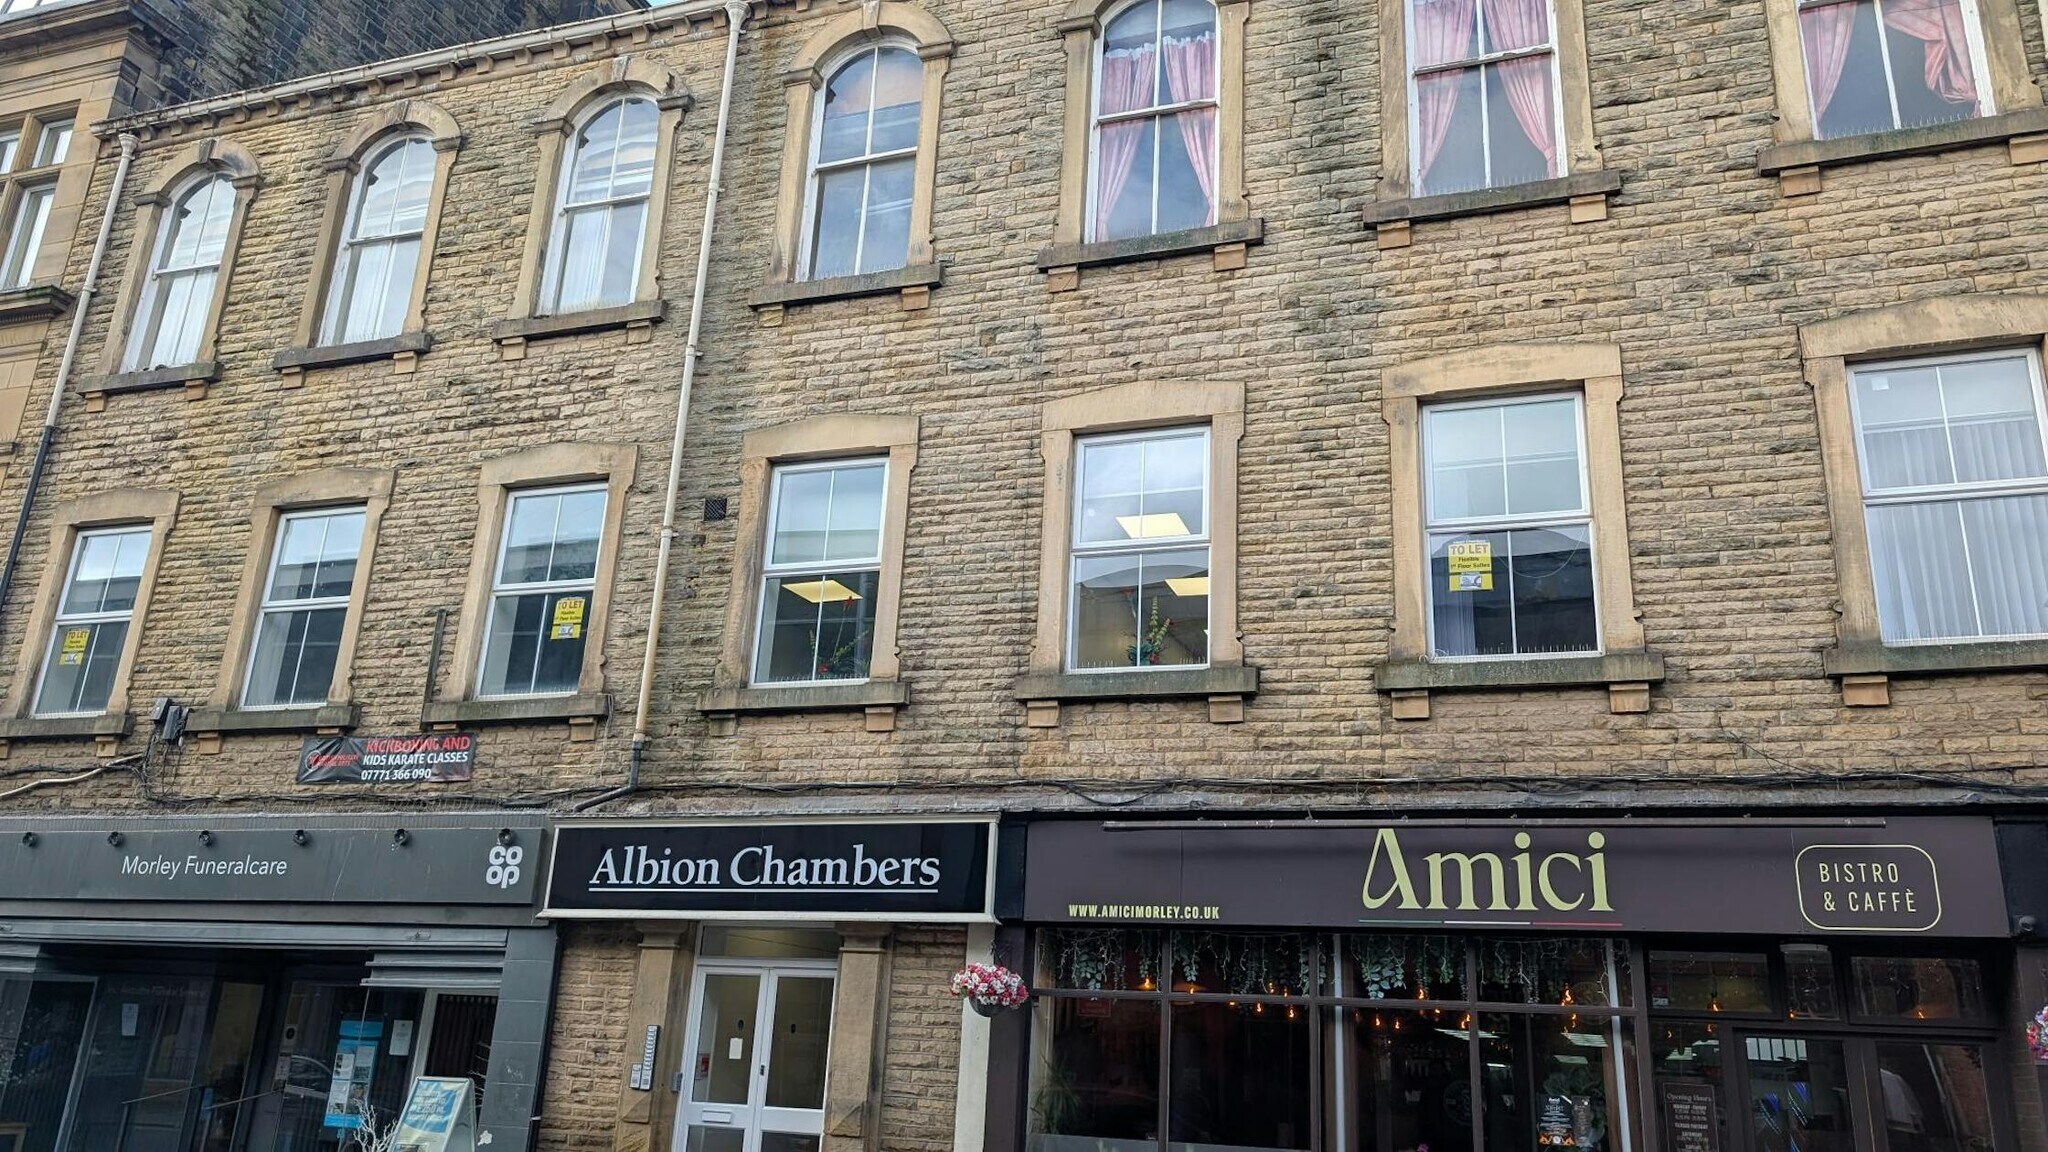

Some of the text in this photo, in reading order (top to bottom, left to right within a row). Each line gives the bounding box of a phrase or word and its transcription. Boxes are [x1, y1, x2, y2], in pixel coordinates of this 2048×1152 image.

[1451, 544, 1488, 555] TO LET
[366, 736, 470, 753] KICKBOXING AND
[363, 754, 386, 766] KIDS
[388, 753, 425, 766] KARATE
[427, 751, 469, 764] CLASSES
[361, 768, 432, 780] 07771 366 090
[121, 854, 287, 880] Morley Funeralcare
[589, 844, 941, 886] Albion Chambers
[1362, 828, 1616, 912] Amici
[1819, 862, 1899, 883] BISTRO
[1823, 888, 1917, 912] & CAFFÈ
[1068, 904, 1220, 919] WWW.AMICIMORLEY.CO.UK
